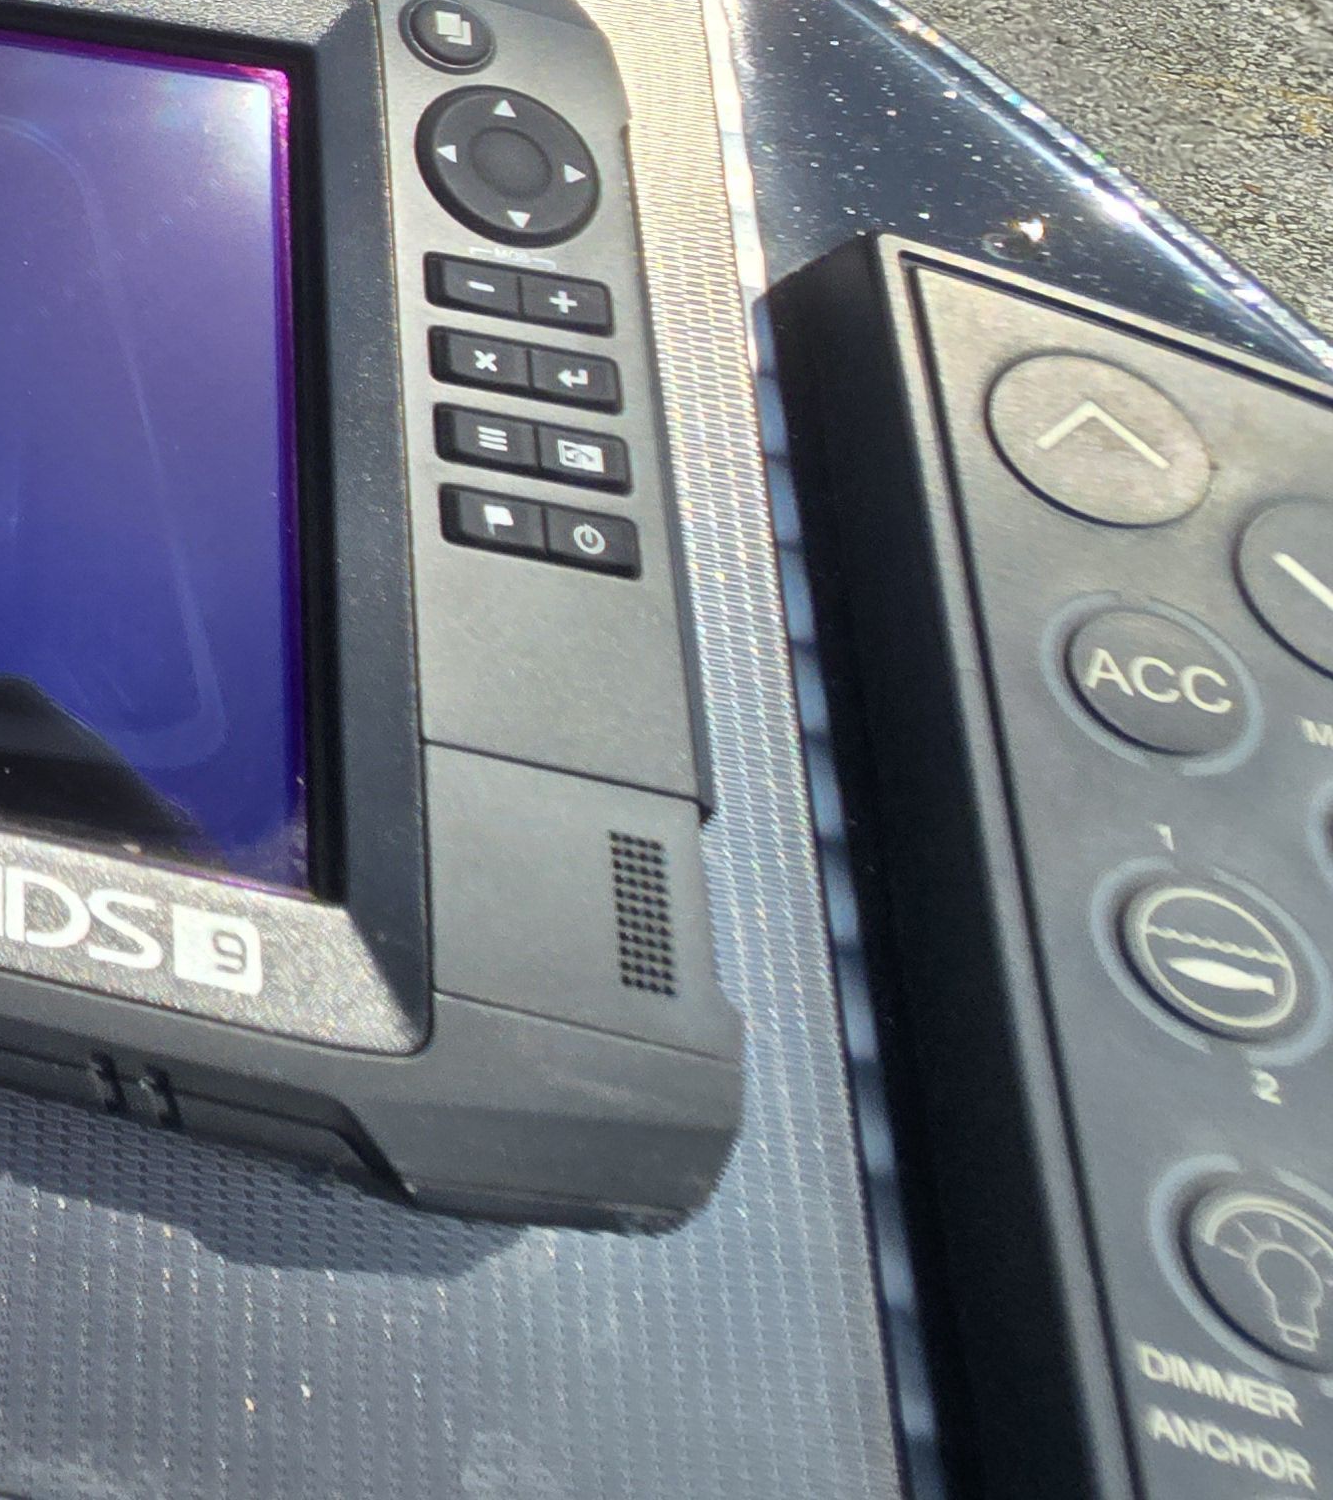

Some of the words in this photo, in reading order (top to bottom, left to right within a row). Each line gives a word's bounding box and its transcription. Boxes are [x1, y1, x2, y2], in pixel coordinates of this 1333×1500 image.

[1084, 648, 1232, 714] ACC
[1140, 1341, 1303, 1427] DIMMER
[1150, 1409, 1316, 1490] ANCHOR
